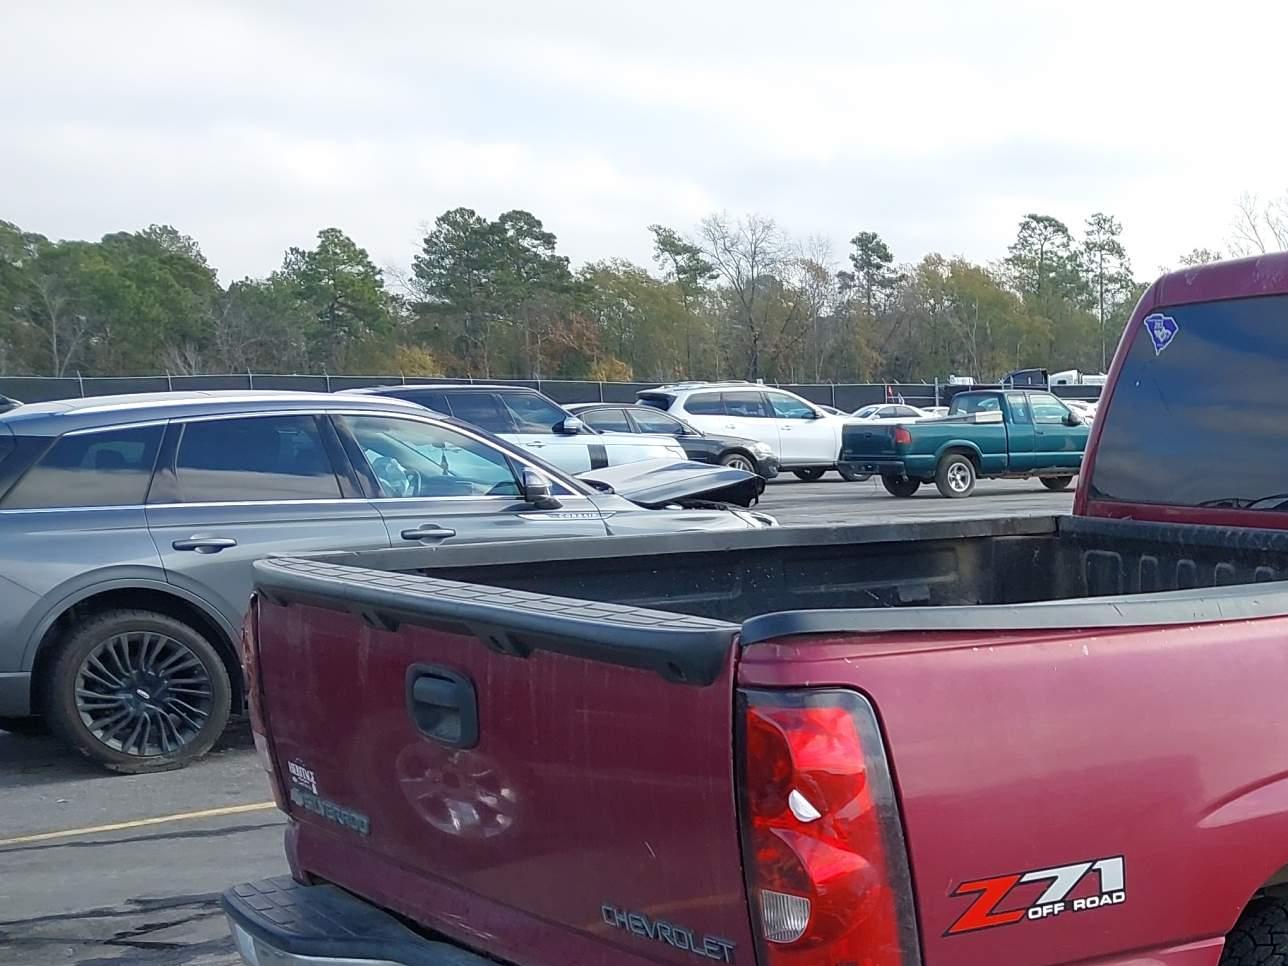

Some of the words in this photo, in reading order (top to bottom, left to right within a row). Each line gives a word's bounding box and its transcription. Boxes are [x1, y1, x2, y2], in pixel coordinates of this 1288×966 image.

[943, 855, 1125, 936] Z71
[1028, 902, 1065, 920] OFF
[1073, 892, 1125, 911] ROAD
[601, 905, 734, 964] CHEVROLET
